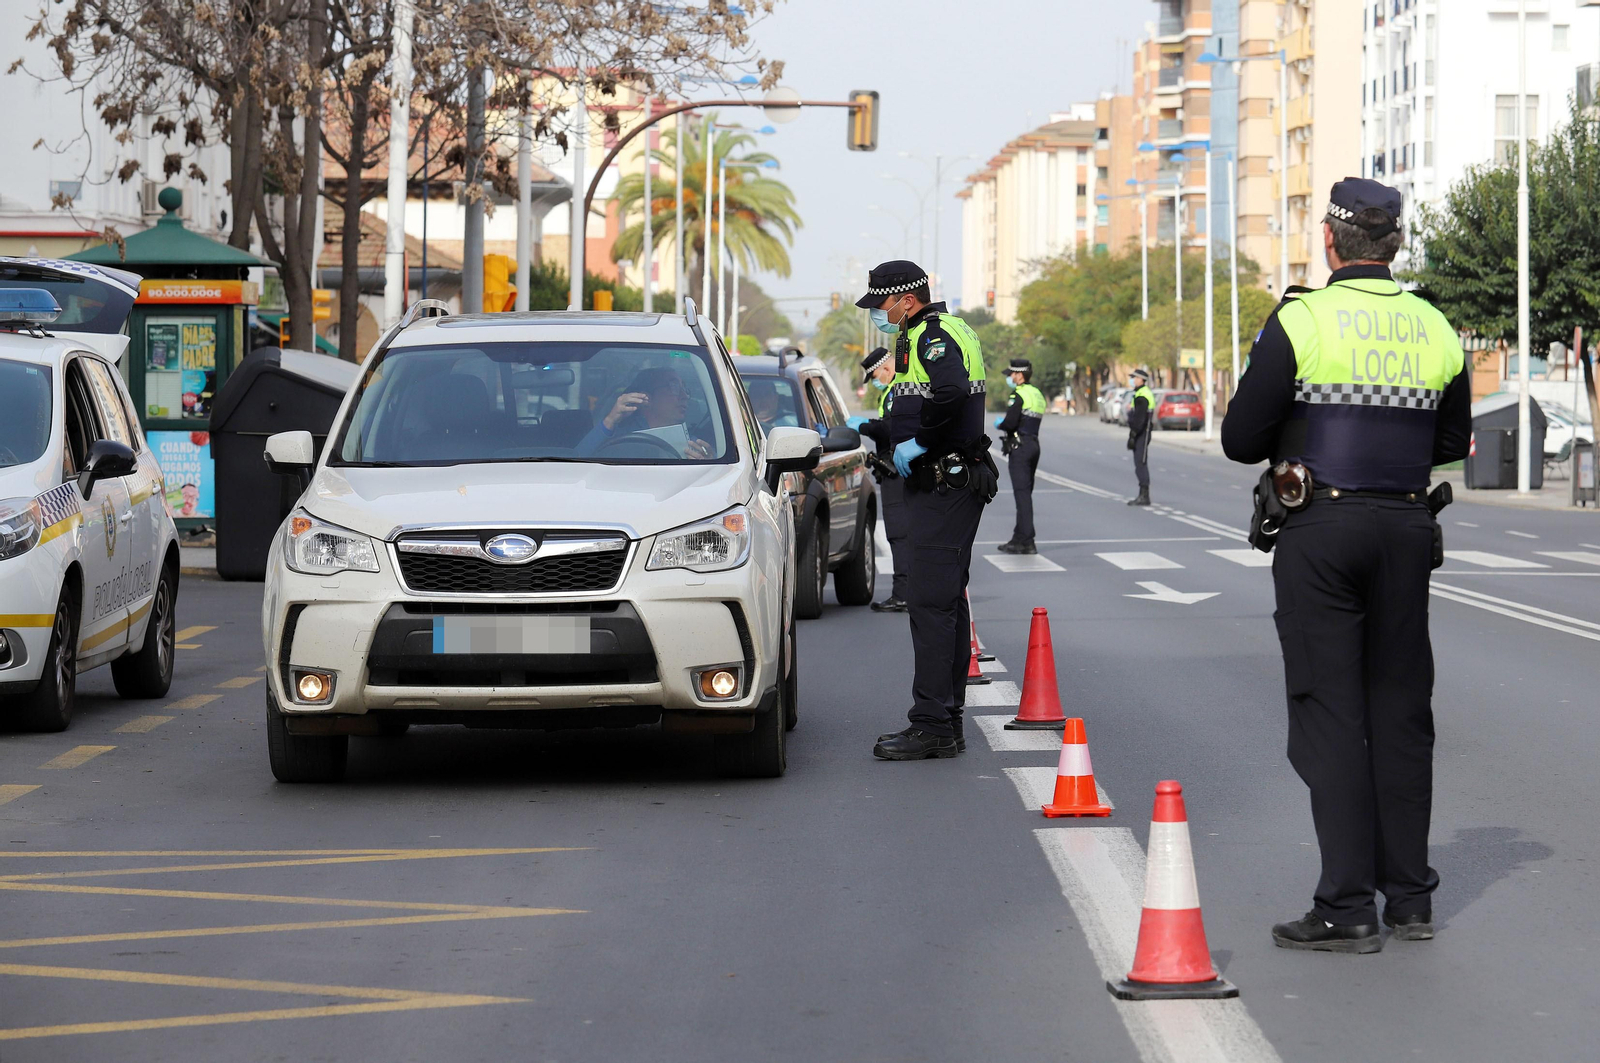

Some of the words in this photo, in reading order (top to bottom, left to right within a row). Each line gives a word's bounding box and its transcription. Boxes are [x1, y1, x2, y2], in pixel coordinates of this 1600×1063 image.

[148, 288, 222, 298] 90.000.000€
[1336, 309, 1430, 345] POLICIA
[183, 345, 216, 369] PADRE
[1351, 348, 1426, 386] LOCAL
[160, 441, 201, 454] CUANDO
[162, 453, 186, 461] JUEGAS
[126, 561, 152, 602] LOCAL
